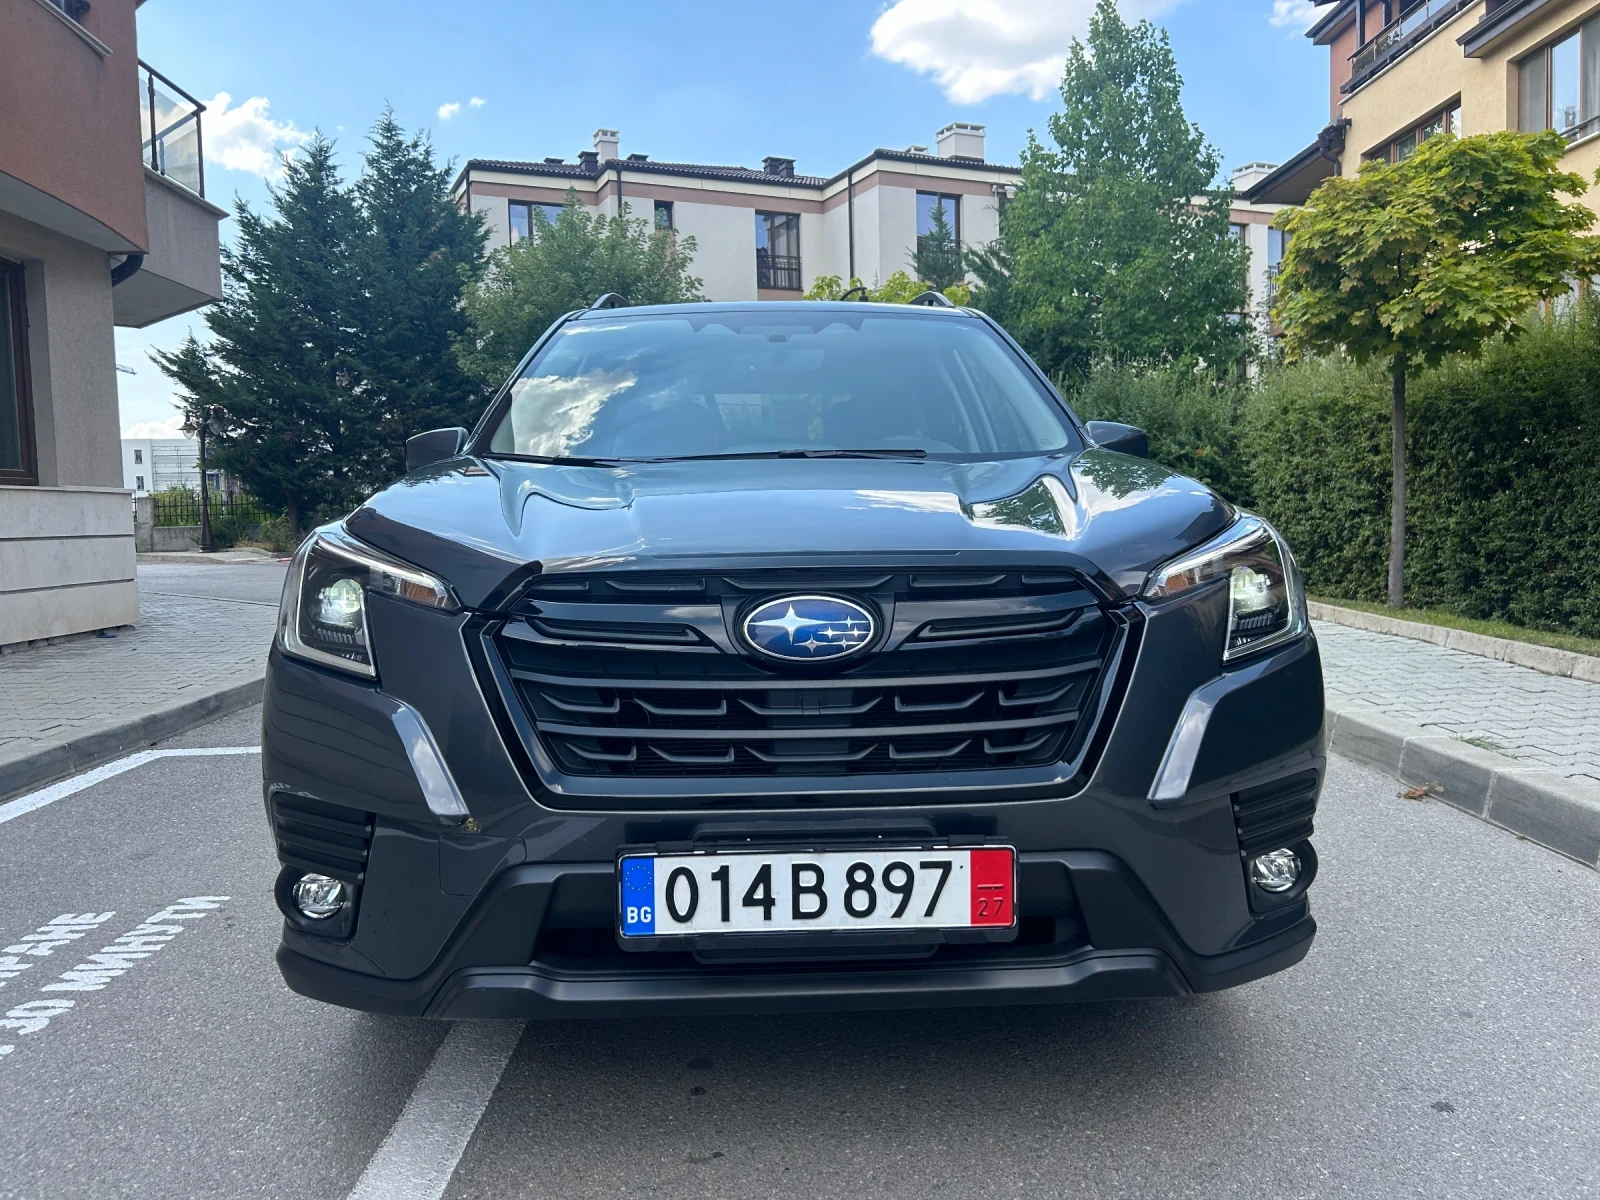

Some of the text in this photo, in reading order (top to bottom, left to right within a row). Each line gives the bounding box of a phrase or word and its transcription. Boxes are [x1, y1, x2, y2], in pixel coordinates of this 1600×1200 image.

[626, 906, 652, 924] BG
[978, 897, 1003, 917] 27
[41, 895, 231, 992] МИНУТИ
